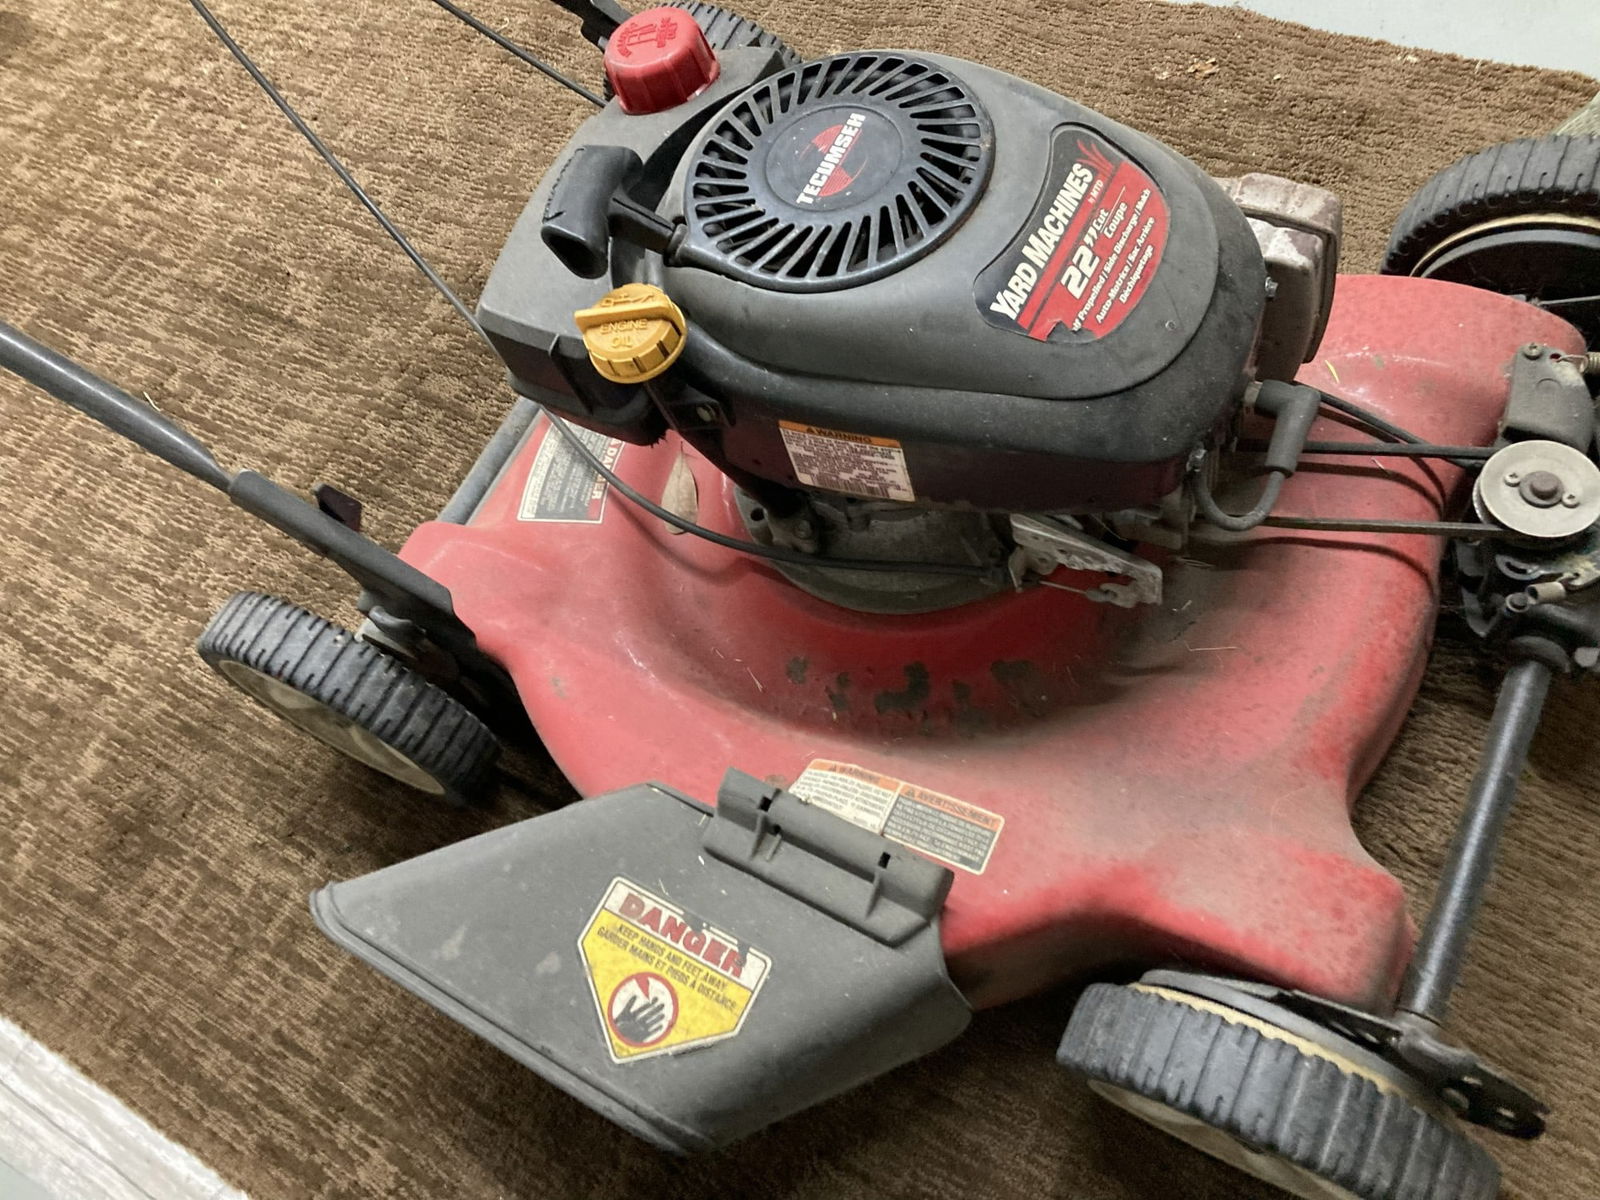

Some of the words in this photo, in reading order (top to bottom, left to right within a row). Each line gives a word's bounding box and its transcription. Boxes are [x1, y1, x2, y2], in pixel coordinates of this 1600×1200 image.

[796, 113, 866, 204] TECUMSEH
[1090, 179, 1104, 198] MTD
[990, 261, 1038, 320] YARD
[1023, 162, 1094, 270] MACHINES
[1095, 209, 1110, 232] Cut
[1104, 202, 1128, 240] Coupe
[1078, 275, 1106, 321] Propelled
[1104, 252, 1119, 274] Side
[1114, 213, 1141, 257] Discharge
[1137, 188, 1152, 213] Mulch
[1096, 264, 1130, 323] Auto-Motrice
[1129, 244, 1140, 263] Sac
[1136, 217, 1155, 247] Arrière
[600, 318, 648, 335] ENGINE
[611, 336, 633, 348] OIL
[815, 428, 873, 444] WARNING
[592, 447, 618, 500] DAER
[597, 926, 629, 951] GARDER
[628, 942, 655, 967] MAINS
[654, 956, 666, 971] ET
[666, 965, 690, 985] PIEDS
[617, 924, 639, 941] KEEP
[639, 935, 665, 958] HANDS
[665, 951, 683, 967] AND
[682, 960, 703, 977] FEET
[702, 971, 728, 991] AWAY
[619, 894, 748, 978] DANGER
